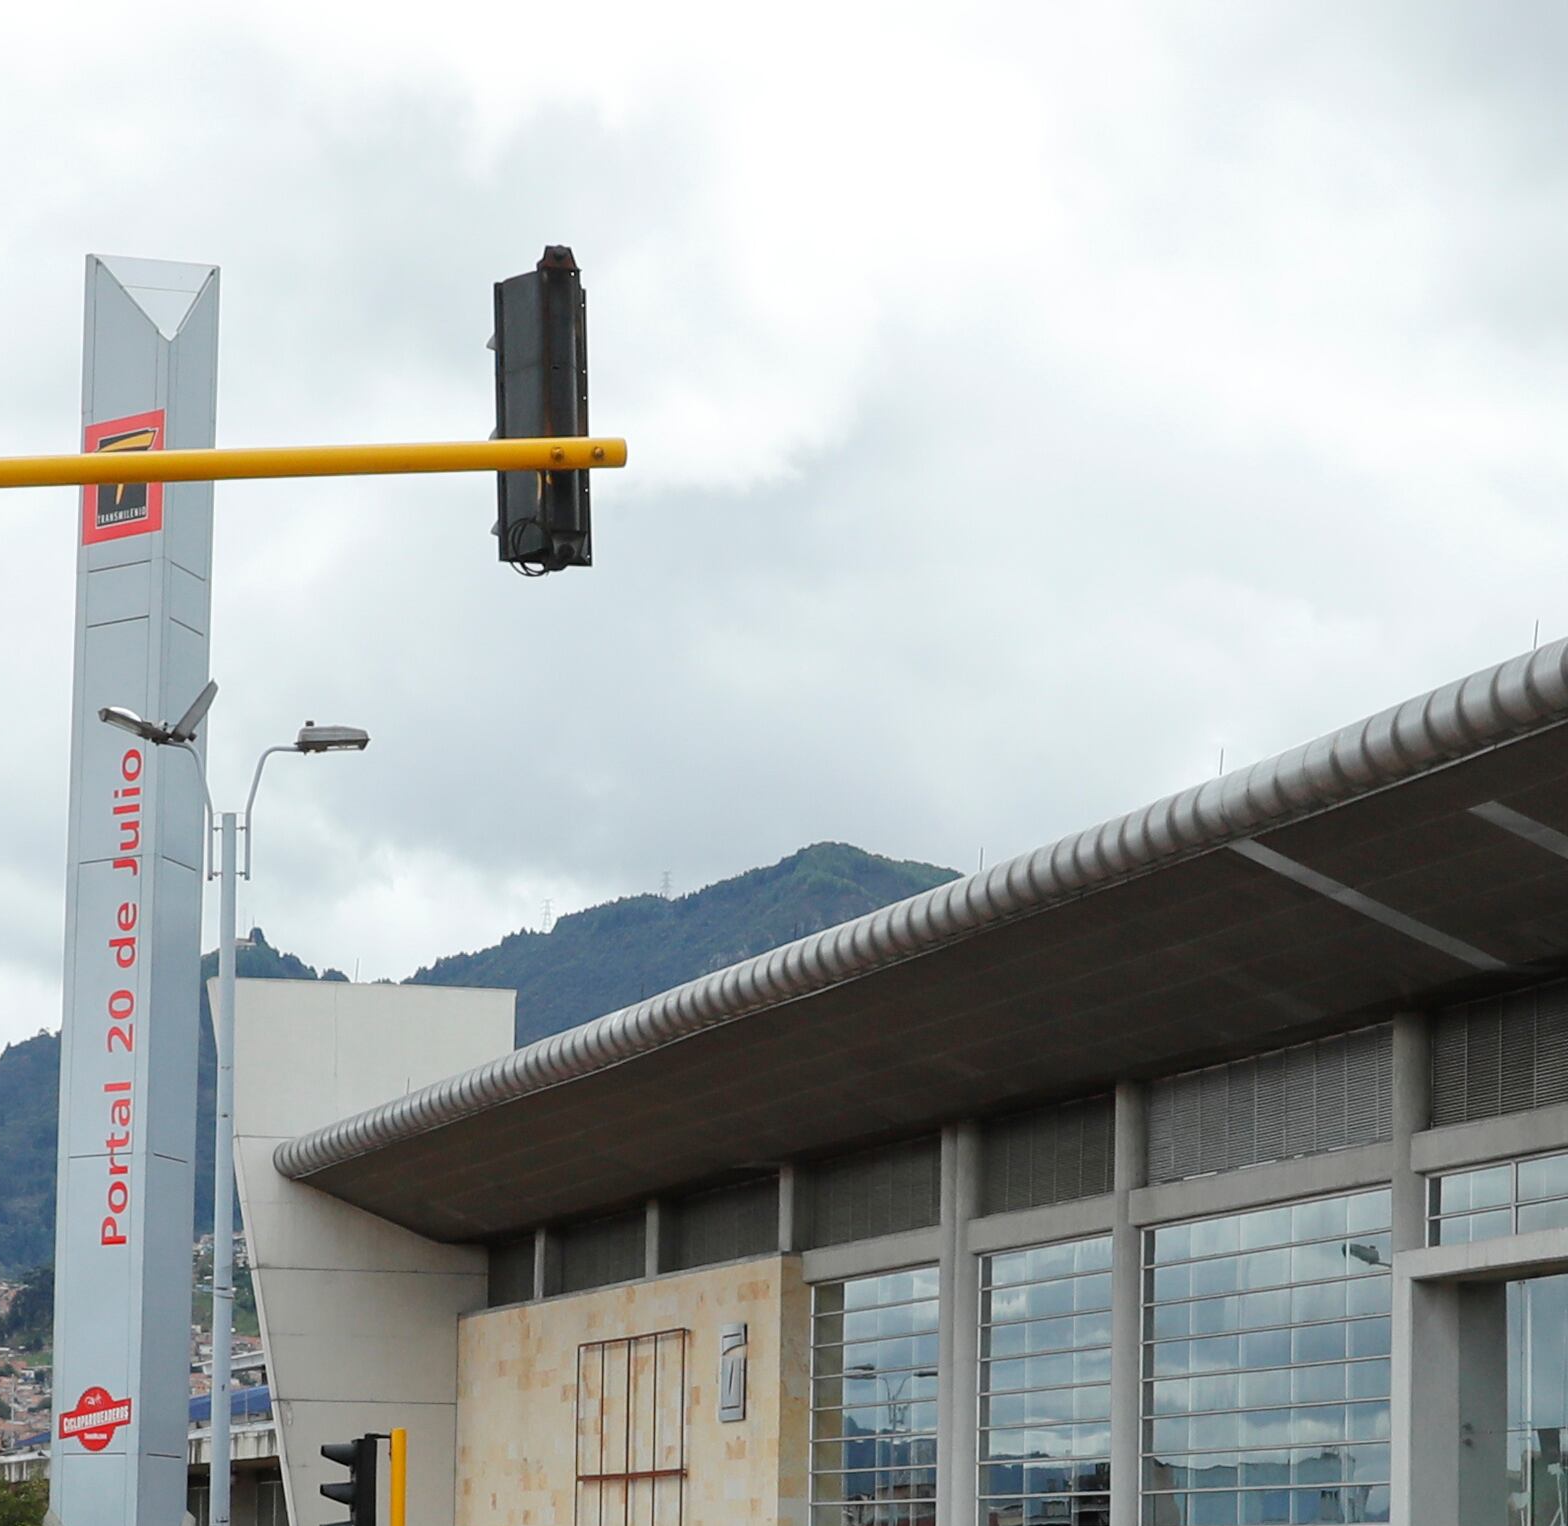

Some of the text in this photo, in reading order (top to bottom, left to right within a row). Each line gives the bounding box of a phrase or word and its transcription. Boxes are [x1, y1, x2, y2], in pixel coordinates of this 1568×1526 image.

[97, 506, 146, 525] TRANSMILENIO
[101, 748, 143, 1246] Portal 20 de Julio
